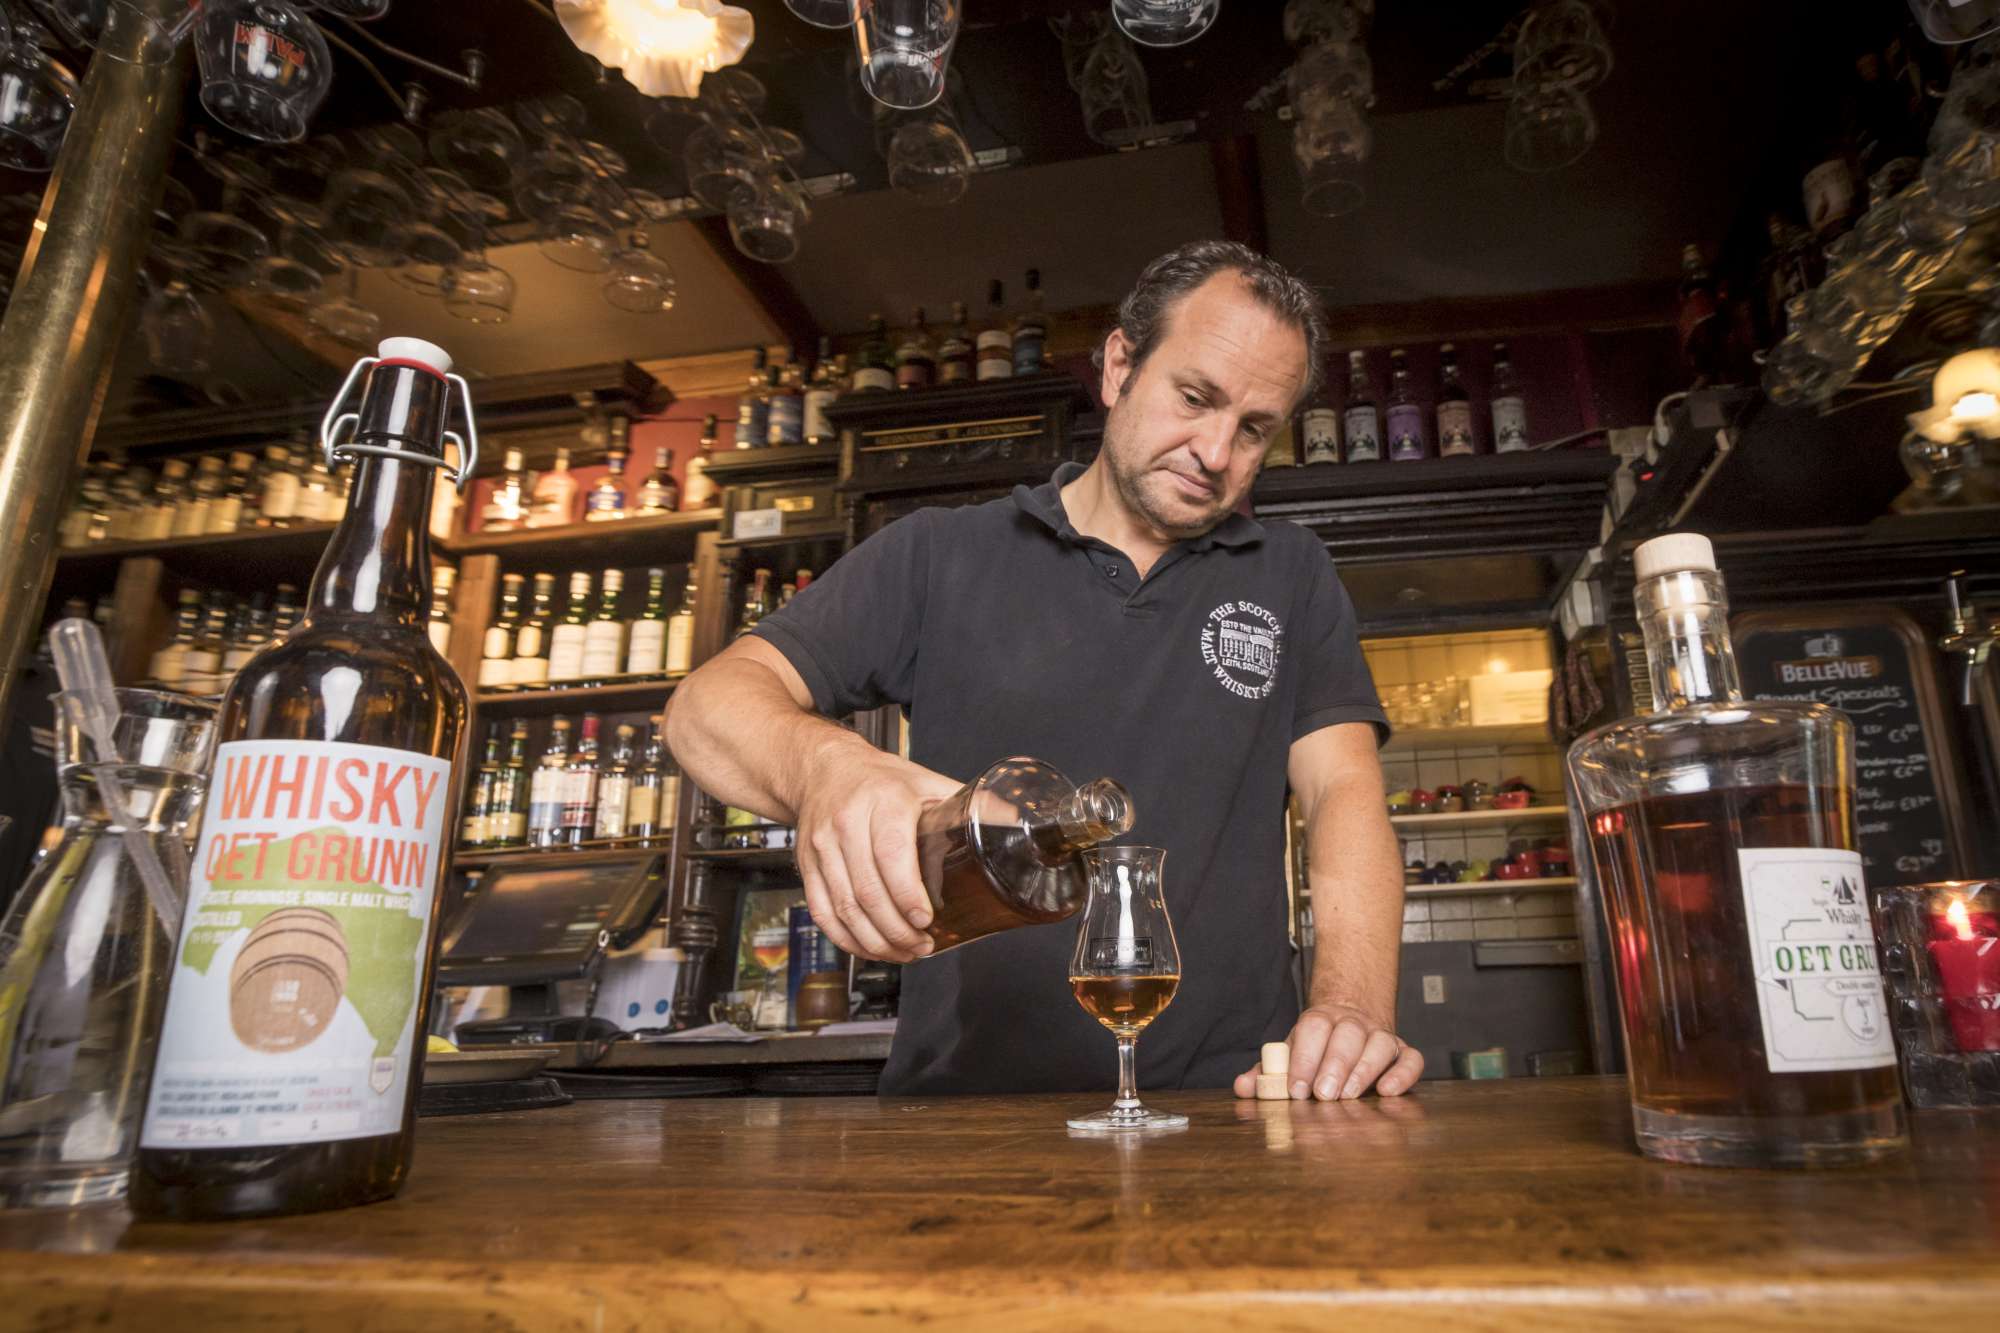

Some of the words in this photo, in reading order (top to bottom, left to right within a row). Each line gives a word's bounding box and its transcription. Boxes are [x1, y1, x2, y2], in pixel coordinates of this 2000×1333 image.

[1209, 602, 1236, 622] THE
[1238, 600, 1281, 635] SCOTCH
[1239, 623, 1252, 634] THE
[1201, 628, 1219, 665] MALT
[1213, 665, 1260, 699] WHISKY
[219, 754, 440, 830] WHISKY
[204, 831, 278, 881] OET
[287, 832, 429, 888] GRUNN
[303, 890, 347, 906] SINGLE
[350, 893, 383, 907] MALT
[1826, 908, 1862, 928] Whisky
[1775, 944, 1832, 972] OET
